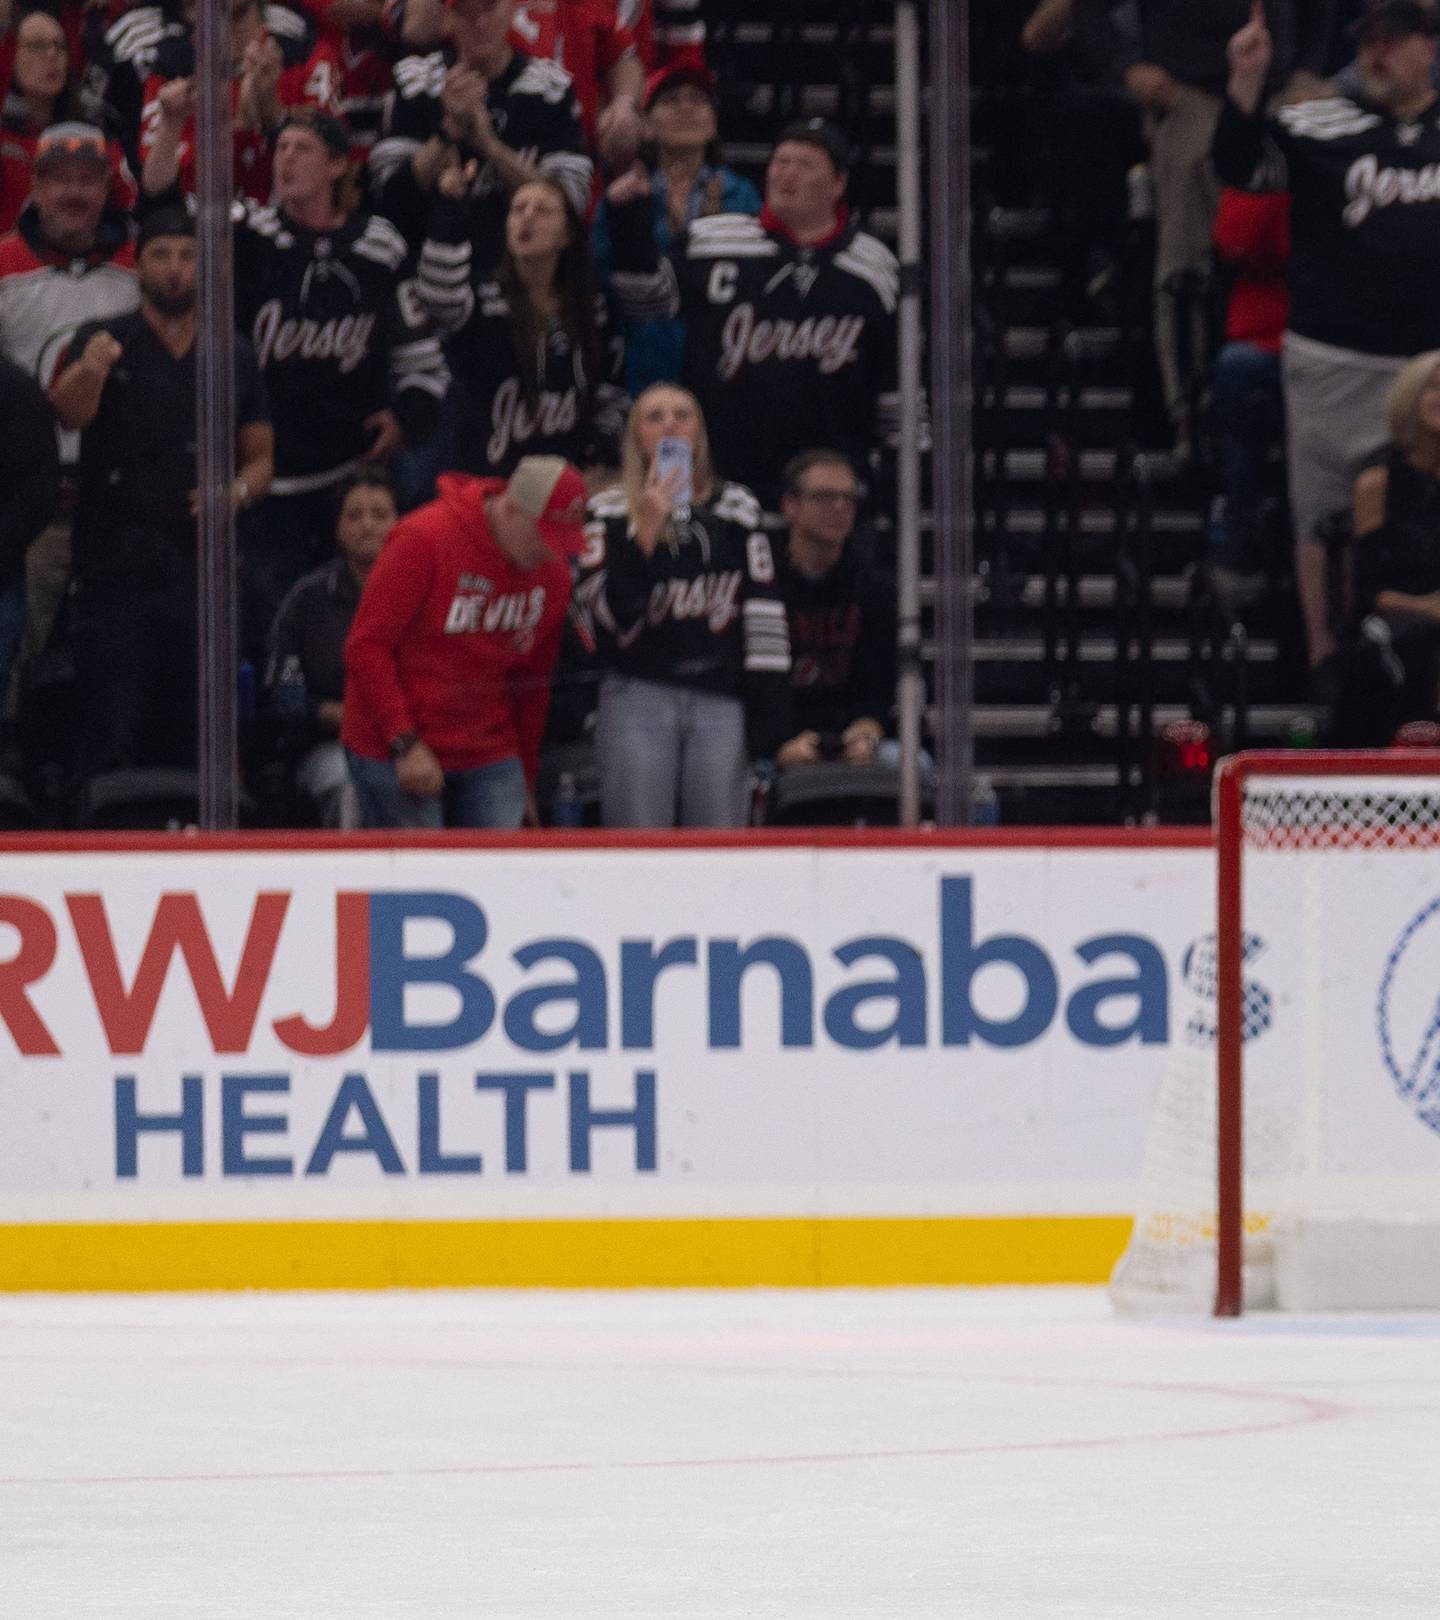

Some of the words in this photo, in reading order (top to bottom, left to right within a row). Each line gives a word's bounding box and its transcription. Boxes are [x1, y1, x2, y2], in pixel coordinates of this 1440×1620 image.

[708, 261, 739, 303] C
[254, 299, 376, 373] Jersey
[717, 303, 866, 380] Jersey
[114, 1070, 660, 1178] HEALTH
